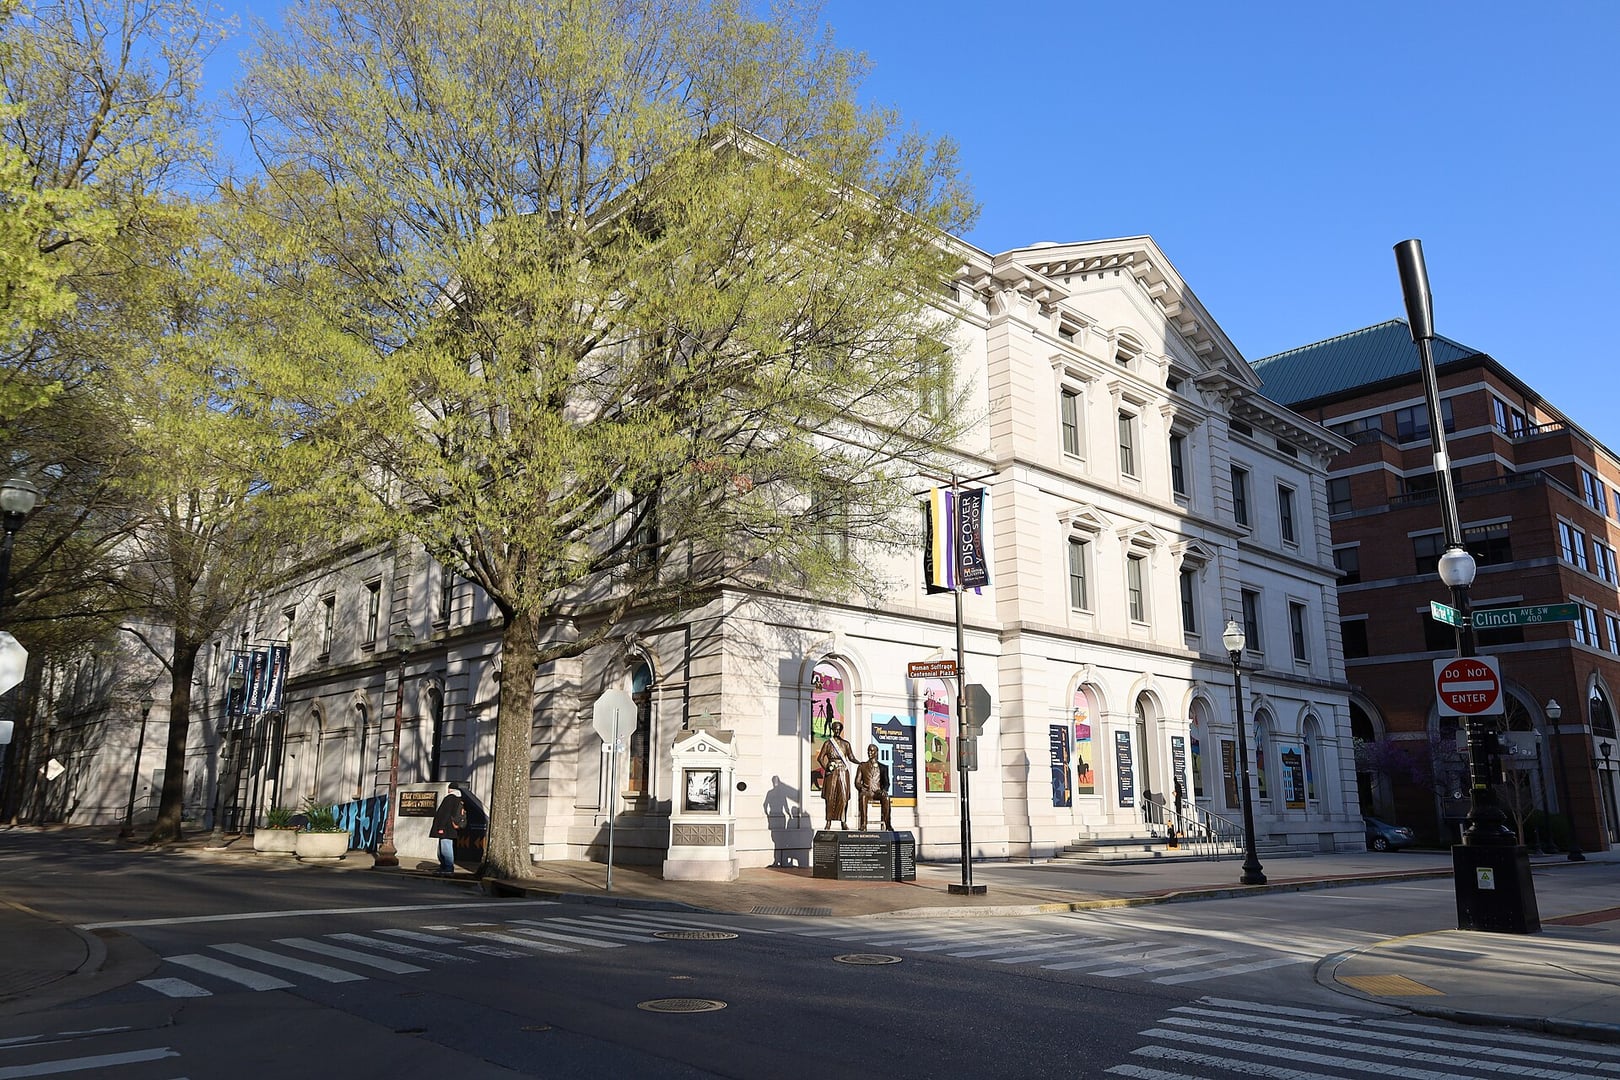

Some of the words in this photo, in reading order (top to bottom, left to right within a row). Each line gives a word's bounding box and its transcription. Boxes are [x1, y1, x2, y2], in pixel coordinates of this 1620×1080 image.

[972, 496, 980, 530] STORY
[962, 496, 973, 566] DISCOVER
[1476, 613, 1517, 627] Clinch
[1520, 608, 1533, 616] AVE
[1537, 607, 1549, 615] SW
[1445, 669, 1460, 679] DO
[1467, 668, 1487, 677] NOT
[1452, 693, 1487, 703] ENTER
